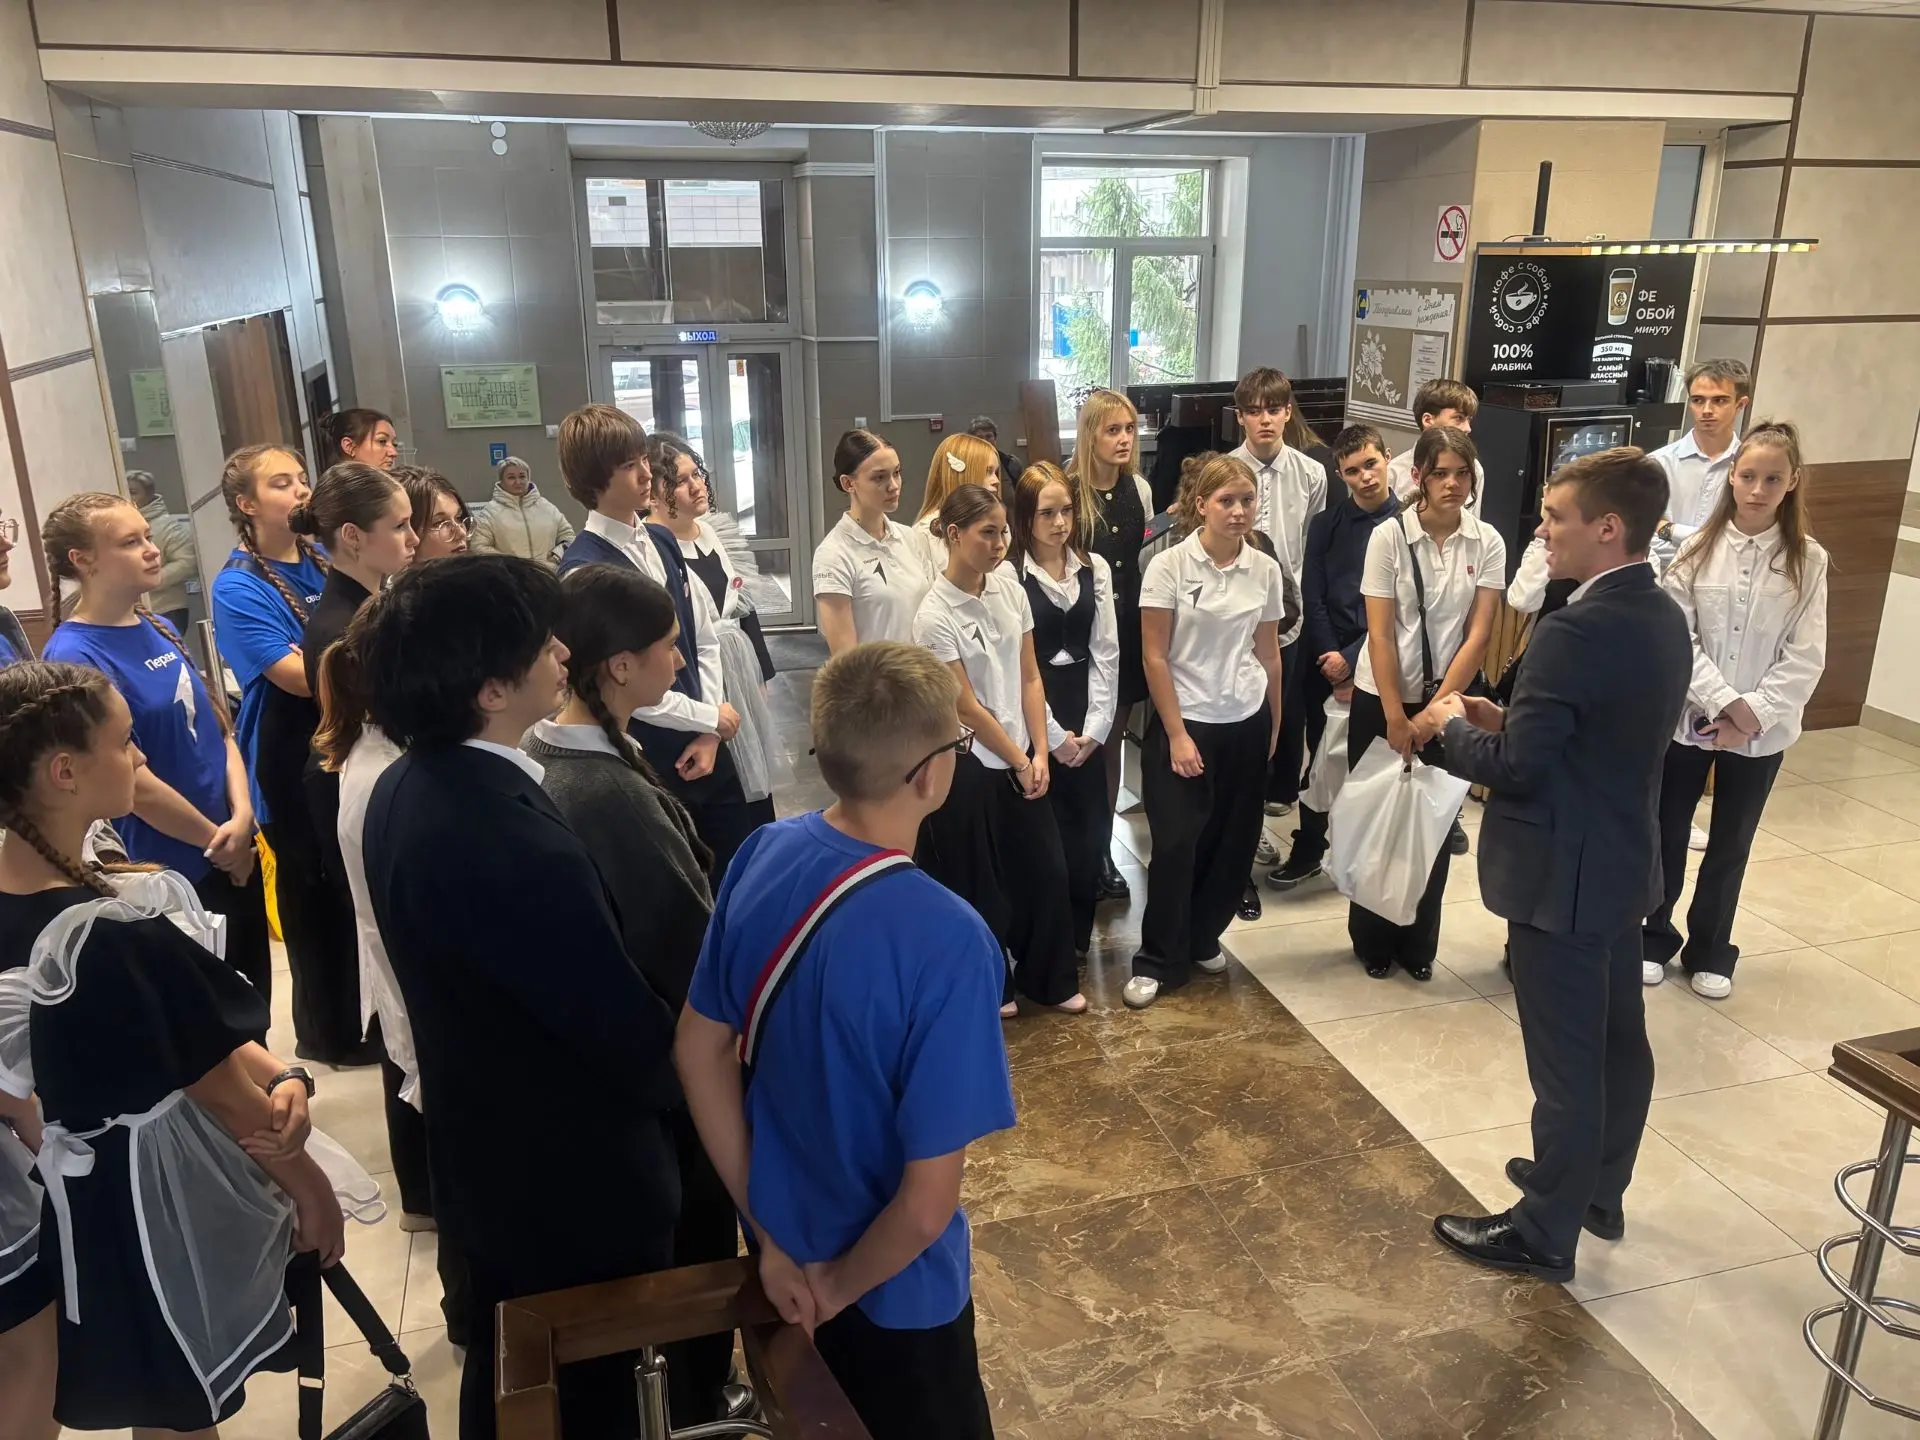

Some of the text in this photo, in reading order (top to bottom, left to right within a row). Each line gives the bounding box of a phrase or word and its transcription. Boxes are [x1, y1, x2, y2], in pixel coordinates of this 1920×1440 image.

[1492, 262, 1552, 294] кофе с собой
[1638, 289, 1657, 303] ФЕ
[1488, 302, 1549, 333] кофе с собой
[1635, 305, 1676, 320] ОБОЙ
[678, 331, 716, 342] ВЫХОД
[1492, 343, 1534, 359] 100%
[1600, 345, 1613, 353] 350
[1490, 362, 1533, 371] АРАБИКА
[1597, 363, 1623, 372] САМЫЙ
[1590, 370, 1629, 379] КЛАССНЫЙ
